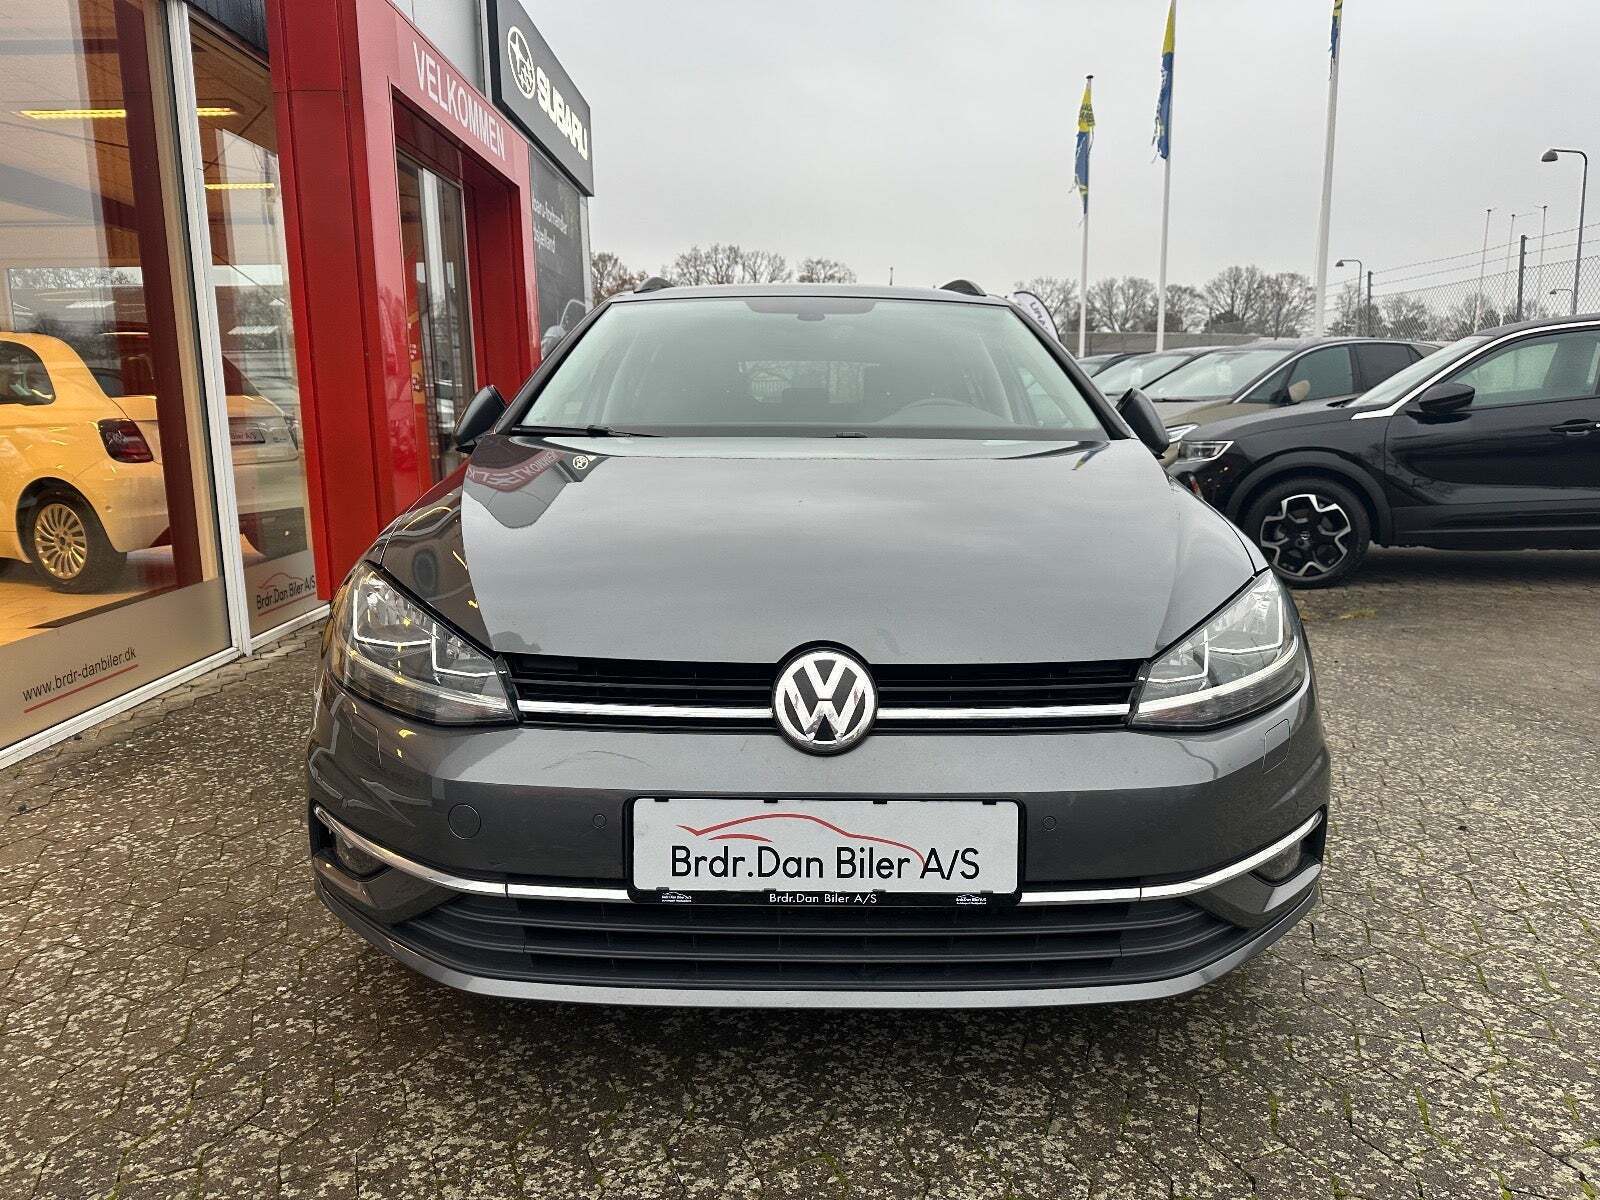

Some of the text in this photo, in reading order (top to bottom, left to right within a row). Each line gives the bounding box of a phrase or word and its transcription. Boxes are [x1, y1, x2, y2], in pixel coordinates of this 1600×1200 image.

[412, 40, 505, 161] VELKOMMEN
[536, 66, 588, 161] SUBARU
[289, 581, 304, 597] Biler
[304, 574, 316, 592] A/S
[22, 646, 137, 702] www.brdr-danbiler.dk
[670, 845, 980, 881] Brdr.Dan Biler A/S
[769, 892, 878, 905] Brdr.Dan Biler A/S
